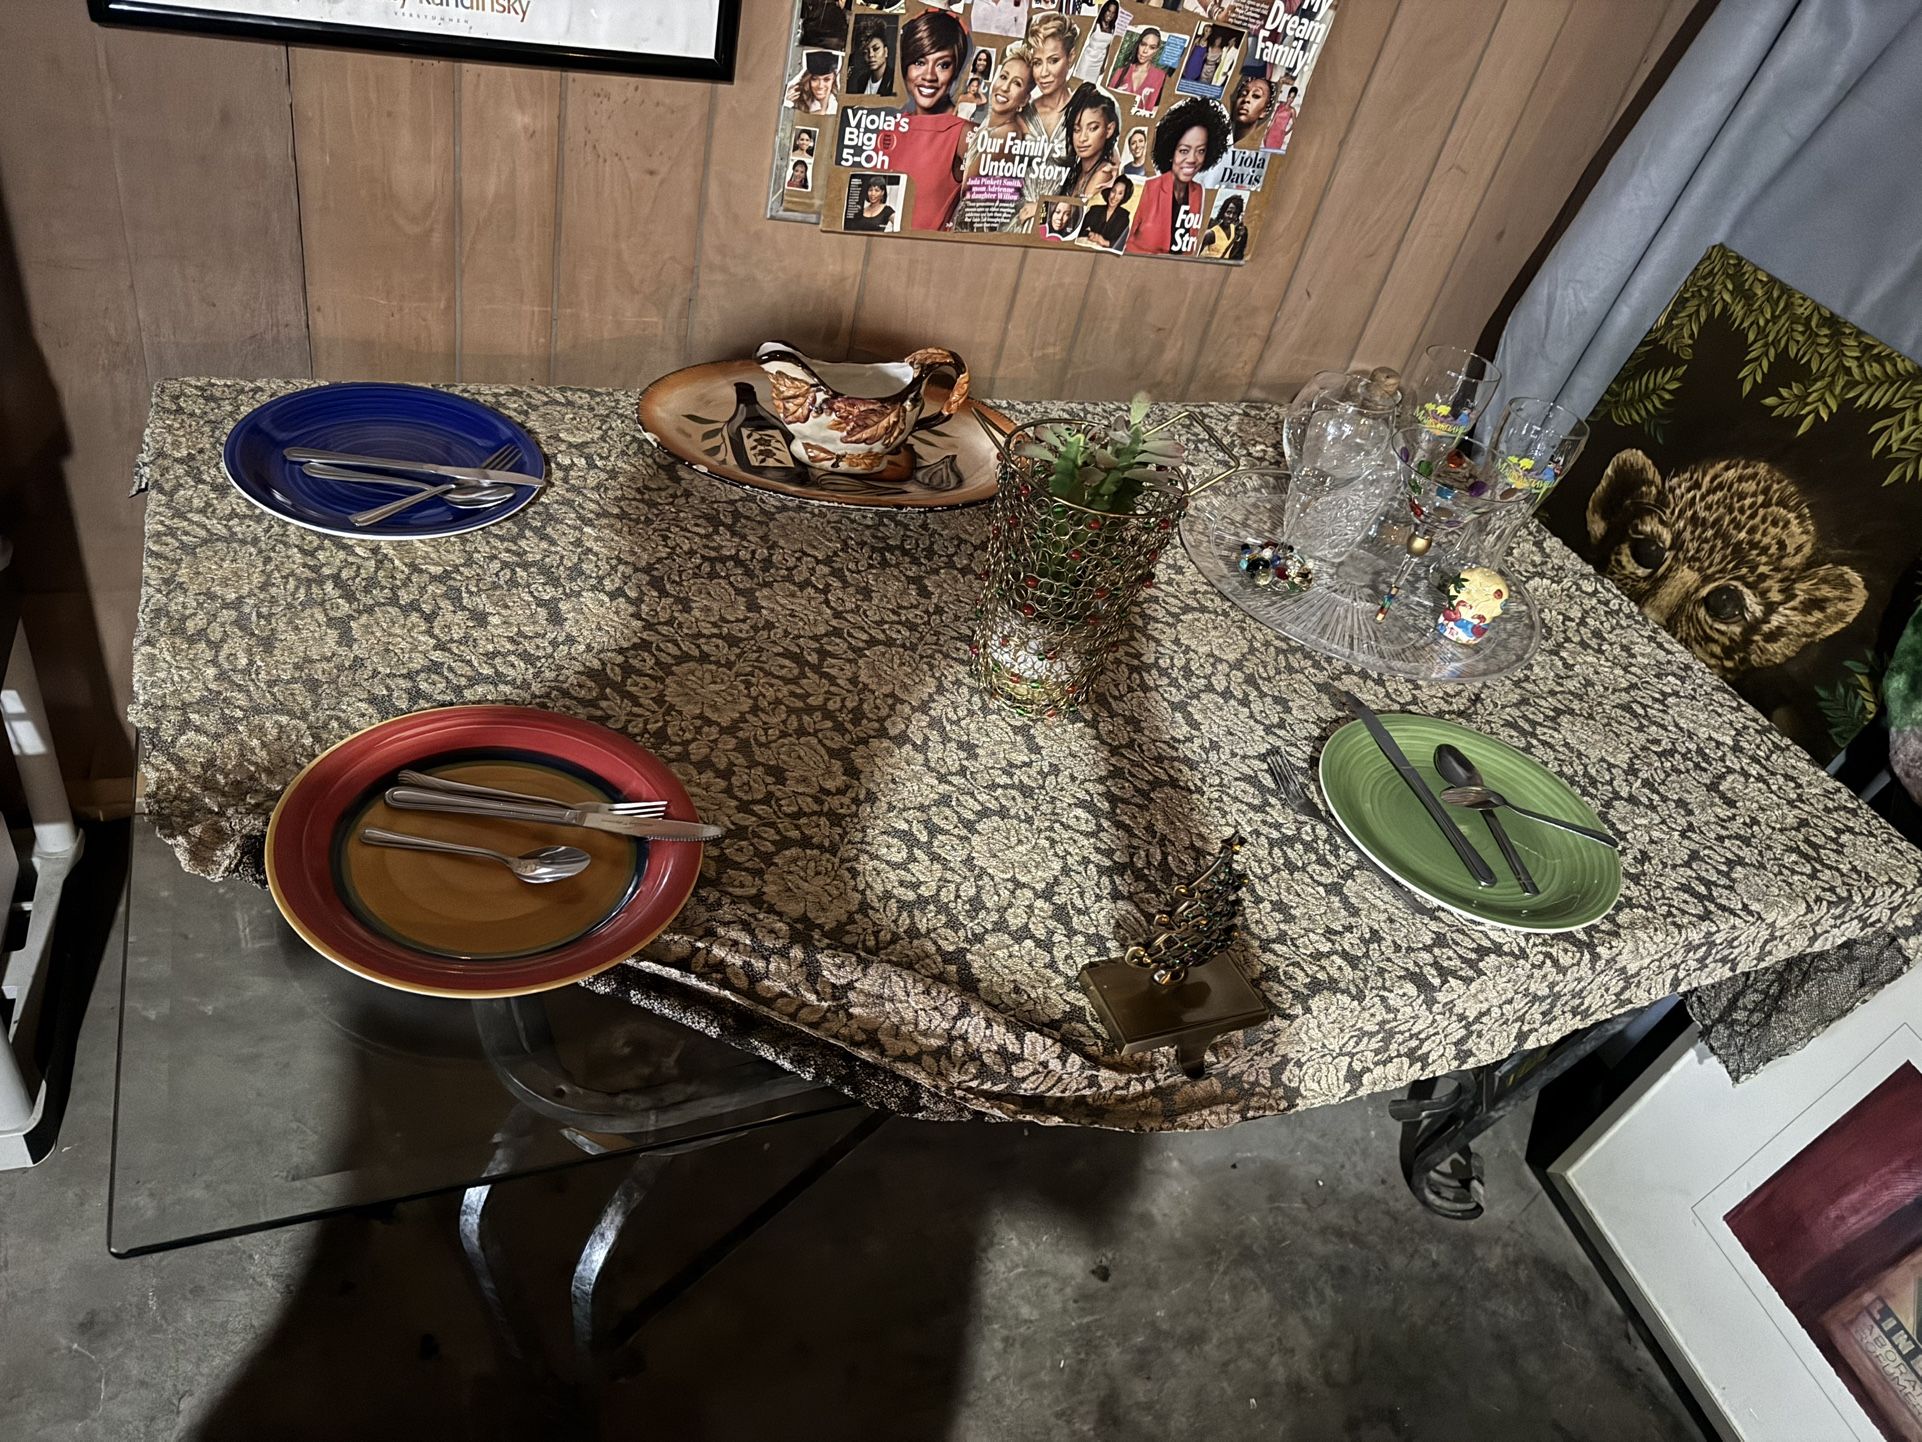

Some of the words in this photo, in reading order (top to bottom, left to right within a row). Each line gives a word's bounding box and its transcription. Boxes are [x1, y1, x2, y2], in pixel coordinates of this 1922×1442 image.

[419, 0, 530, 23] ninsky
[1265, 0, 1326, 43] Dream
[1255, 29, 1318, 77] Family!
[847, 108, 910, 133] Viola's
[843, 127, 877, 151] Big
[977, 131, 1004, 153] Our
[1004, 132, 1062, 162] Family's
[840, 148, 890, 170] 5-Oh
[979, 154, 1029, 178] Untold
[1030, 158, 1071, 186] Story
[1230, 150, 1266, 170] Viola
[1220, 166, 1263, 186] Davis
[1175, 205, 1202, 229] Fou
